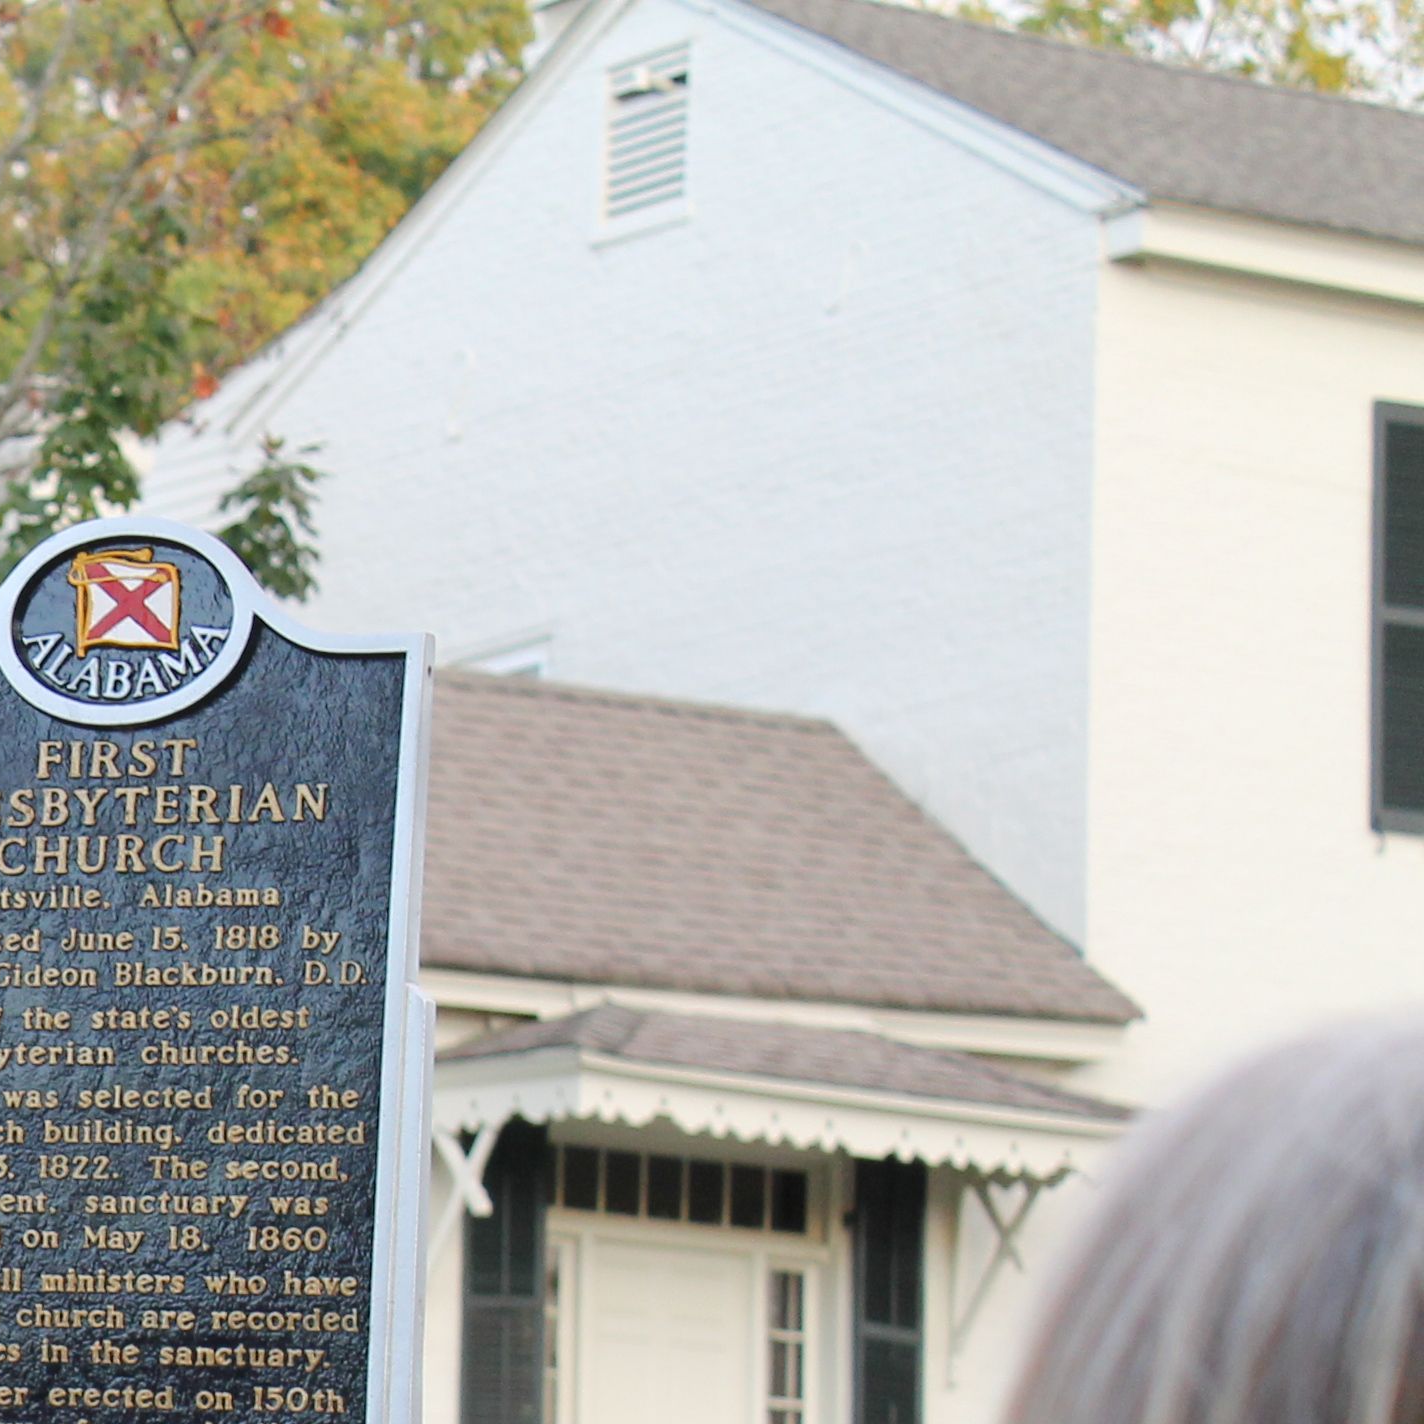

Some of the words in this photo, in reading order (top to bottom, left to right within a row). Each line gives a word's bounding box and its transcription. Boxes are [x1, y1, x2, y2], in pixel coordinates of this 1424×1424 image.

[21, 623, 229, 700] ALABAMA
[37, 738, 197, 780] FIRST
[139, 884, 280, 908] Alabama
[61, 929, 133, 952] June
[151, 927, 190, 953] 15,
[214, 926, 279, 950] 1818
[302, 925, 340, 954] by
[22, 1007, 71, 1030] the
[91, 1006, 192, 1030] state's
[210, 1006, 310, 1029] oldest
[141, 1041, 299, 1066] churches.
[3, 1091, 58, 1109] was
[79, 1086, 212, 1109] selected
[236, 1085, 284, 1109] for
[306, 1085, 359, 1108] the
[43, 1121, 183, 1150] building,
[207, 1121, 365, 1145] dedicated
[38, 1155, 120, 1180] 1822.
[149, 1156, 209, 1180] The
[225, 1156, 348, 1183] second,
[84, 1192, 248, 1218] sanctuary
[271, 1196, 329, 1215] was
[22, 1231, 61, 1250] on
[82, 1227, 145, 1254] May
[168, 1227, 209, 1254] 18,
[40, 1269, 186, 1294] ministers
[205, 1271, 266, 1295] who
[283, 1271, 357, 1296] have
[15, 1304, 125, 1329] church
[141, 1312, 195, 1330] are
[211, 1308, 358, 1332] recorded
[41, 1340, 69, 1363] in
[90, 1341, 140, 1365] the
[159, 1344, 331, 1372] sanctuary.
[48, 1384, 174, 1409] erected
[195, 1391, 233, 1410] on
[252, 1387, 344, 1412] 150th
